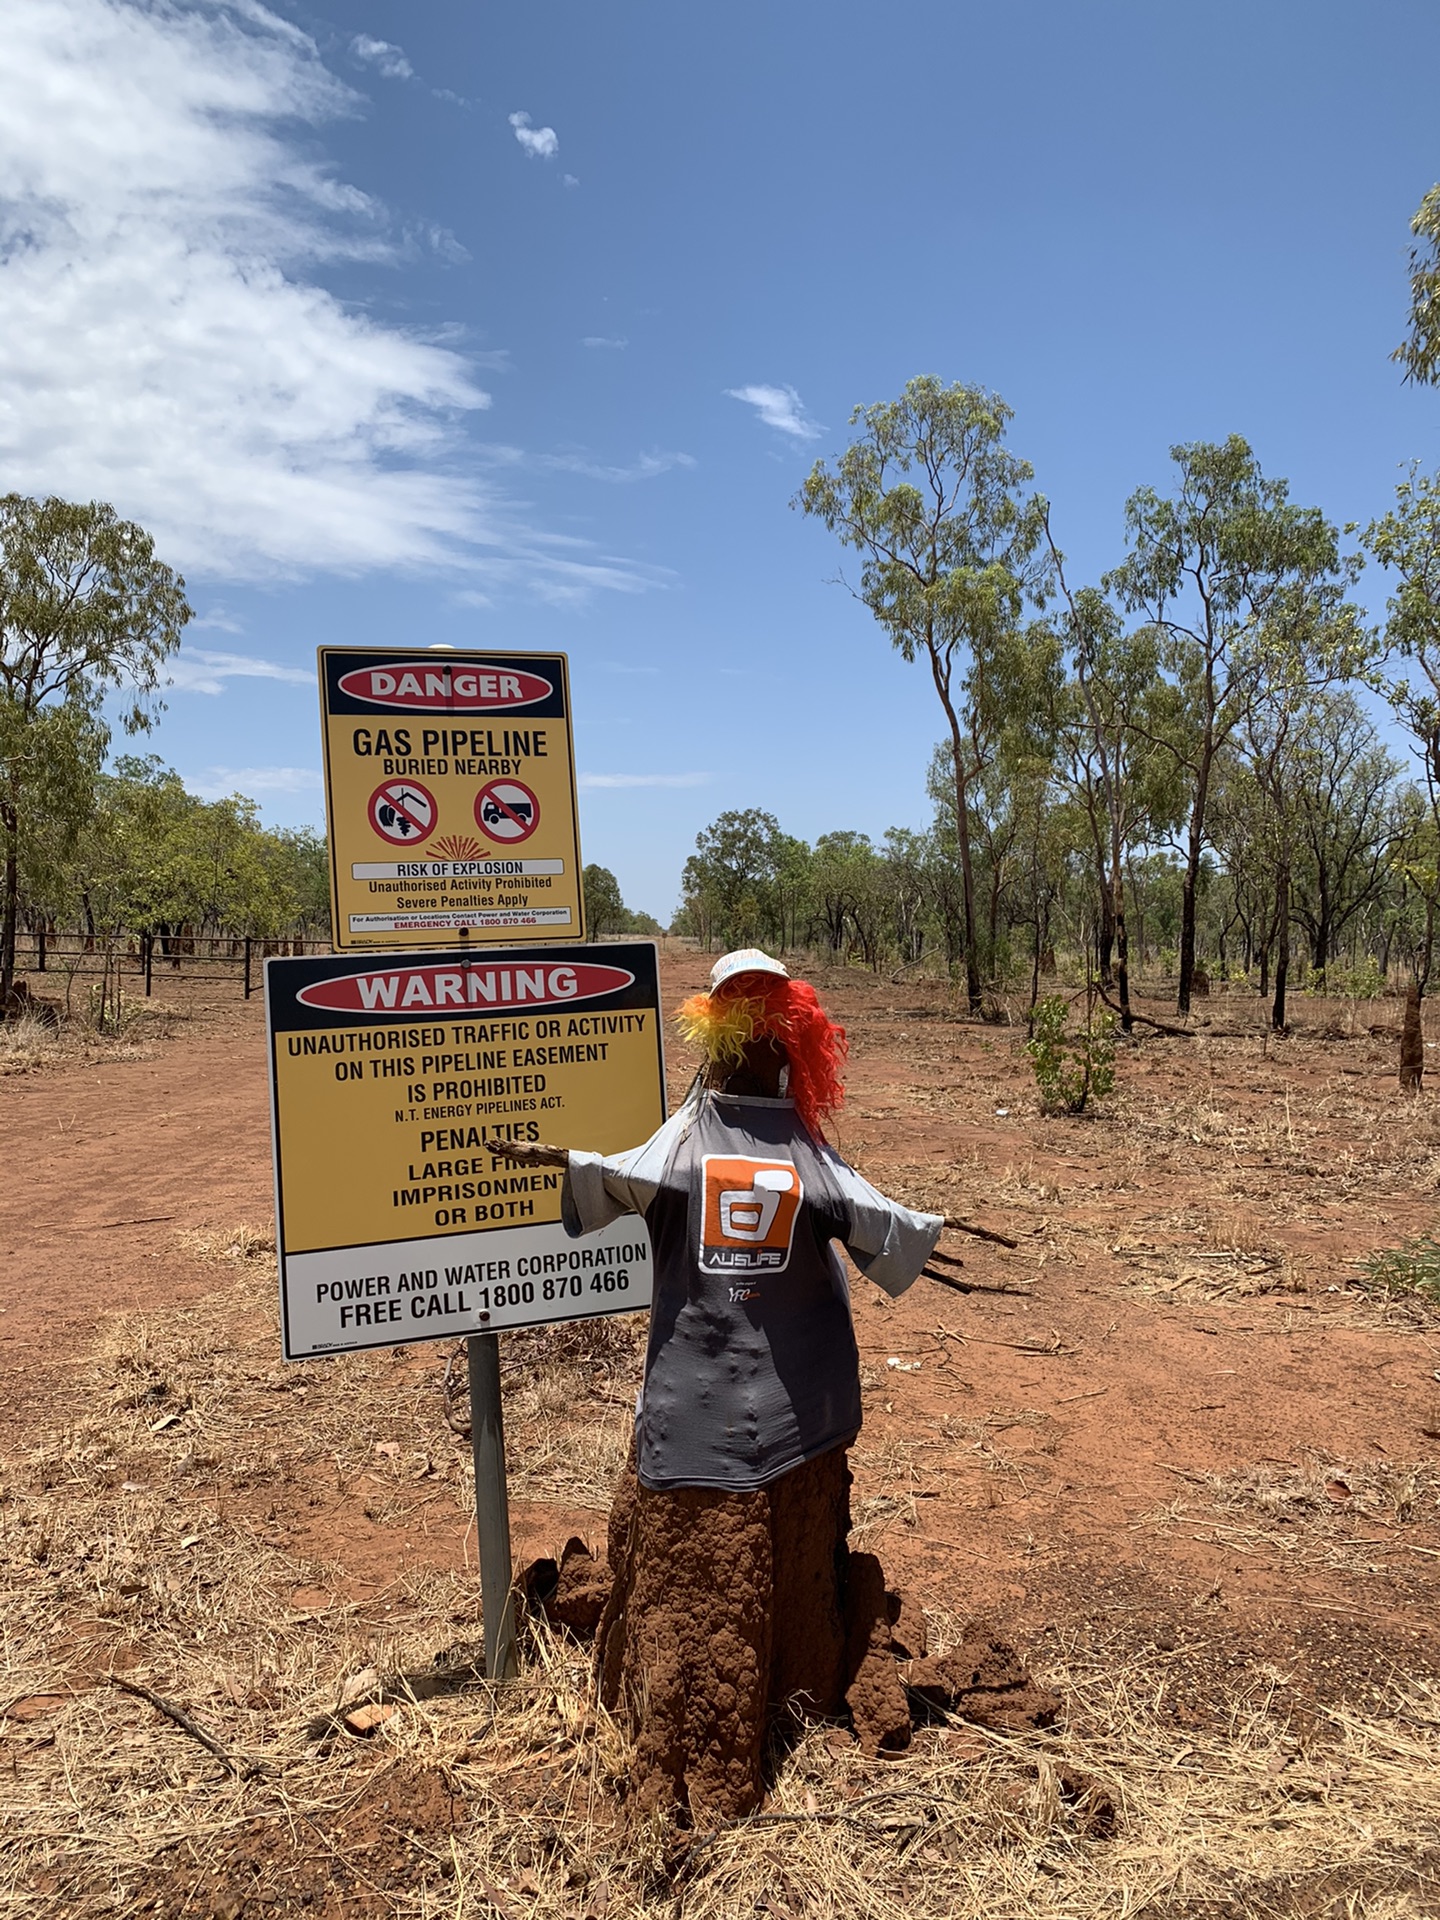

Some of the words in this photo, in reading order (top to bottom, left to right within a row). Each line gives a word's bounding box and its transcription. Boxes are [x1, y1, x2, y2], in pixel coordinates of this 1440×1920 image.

[370, 672, 523, 698] DANGER
[353, 728, 412, 757] GAS
[422, 730, 548, 757] PIPELINE
[384, 759, 448, 775] BURIED
[455, 759, 522, 775] NEARBY
[397, 863, 428, 877] RISK
[432, 862, 449, 875] OF
[453, 861, 523, 875] EXPLOSION
[369, 879, 447, 893] Unauthorised
[450, 877, 492, 893] Activity
[495, 877, 552, 890] Prohibited
[397, 896, 437, 909] Severe
[441, 894, 494, 908] Penalties
[497, 894, 528, 908] Apply
[394, 920, 452, 929] EMERGENCY
[454, 919, 477, 927] CALL
[480, 918, 501, 926] 1800
[355, 967, 579, 1009] WARNING
[287, 1027, 446, 1057] UNAUTHORISED
[451, 1022, 529, 1045] TRAFFIC
[536, 1020, 561, 1039] OR
[566, 1014, 646, 1038] ACTIVITY
[335, 1061, 363, 1082] ON
[369, 1057, 415, 1079] THIS
[422, 1050, 507, 1075] PIPELINE
[513, 1043, 609, 1068] EASEMENT
[407, 1084, 426, 1103] IS
[433, 1074, 547, 1101] PROHIBITED
[395, 1109, 420, 1123] N.T.
[423, 1104, 472, 1120] ENERGY
[476, 1098, 537, 1116] PIPELINES
[540, 1096, 566, 1111] ACT.
[408, 1157, 483, 1181] LARGE
[434, 1207, 467, 1227] OR
[474, 1199, 535, 1223] BOTH
[316, 1275, 391, 1303] POWER
[397, 1269, 438, 1294] AND
[444, 1259, 511, 1286] WATER
[516, 1242, 647, 1277] CORPORATION
[339, 1300, 402, 1329] FREE
[410, 1290, 472, 1319] CALL
[478, 1281, 535, 1310] 1800
[542, 1275, 583, 1301] 870
[589, 1269, 630, 1294] 466
